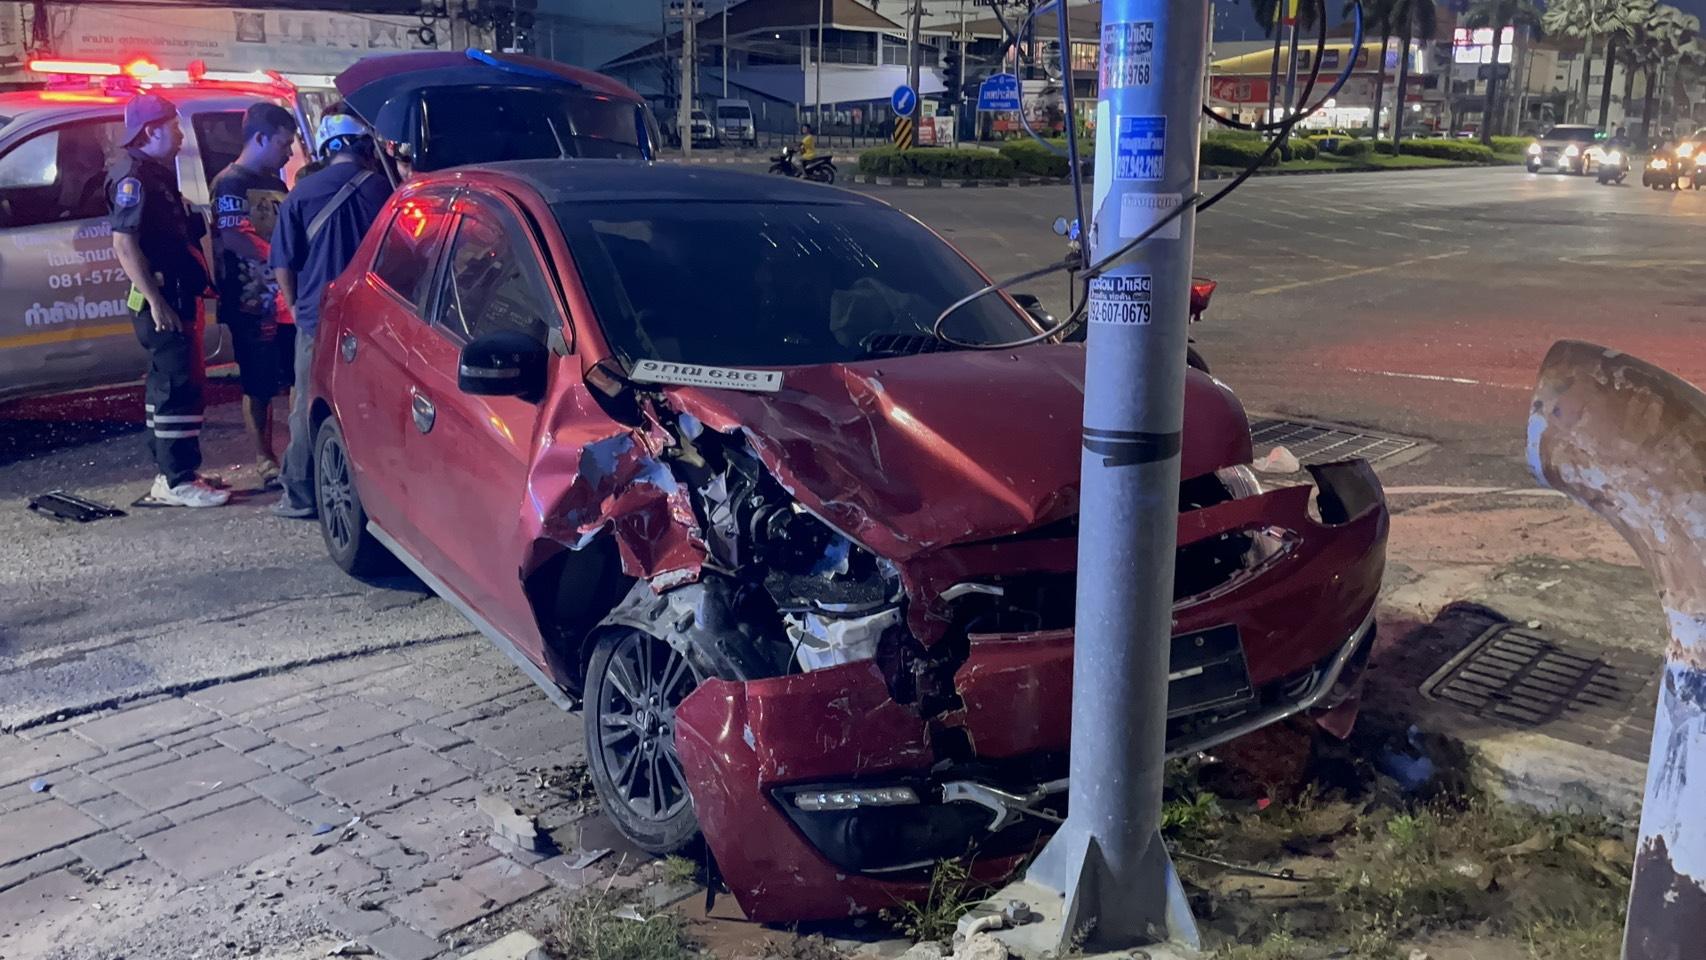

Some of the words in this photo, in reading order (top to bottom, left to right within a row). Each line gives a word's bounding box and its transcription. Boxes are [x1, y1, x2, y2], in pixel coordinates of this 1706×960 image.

[48, 268, 126, 289] 081-572
[25, 295, 131, 326] กำลังใจคน
[707, 366, 775, 383] 6861
